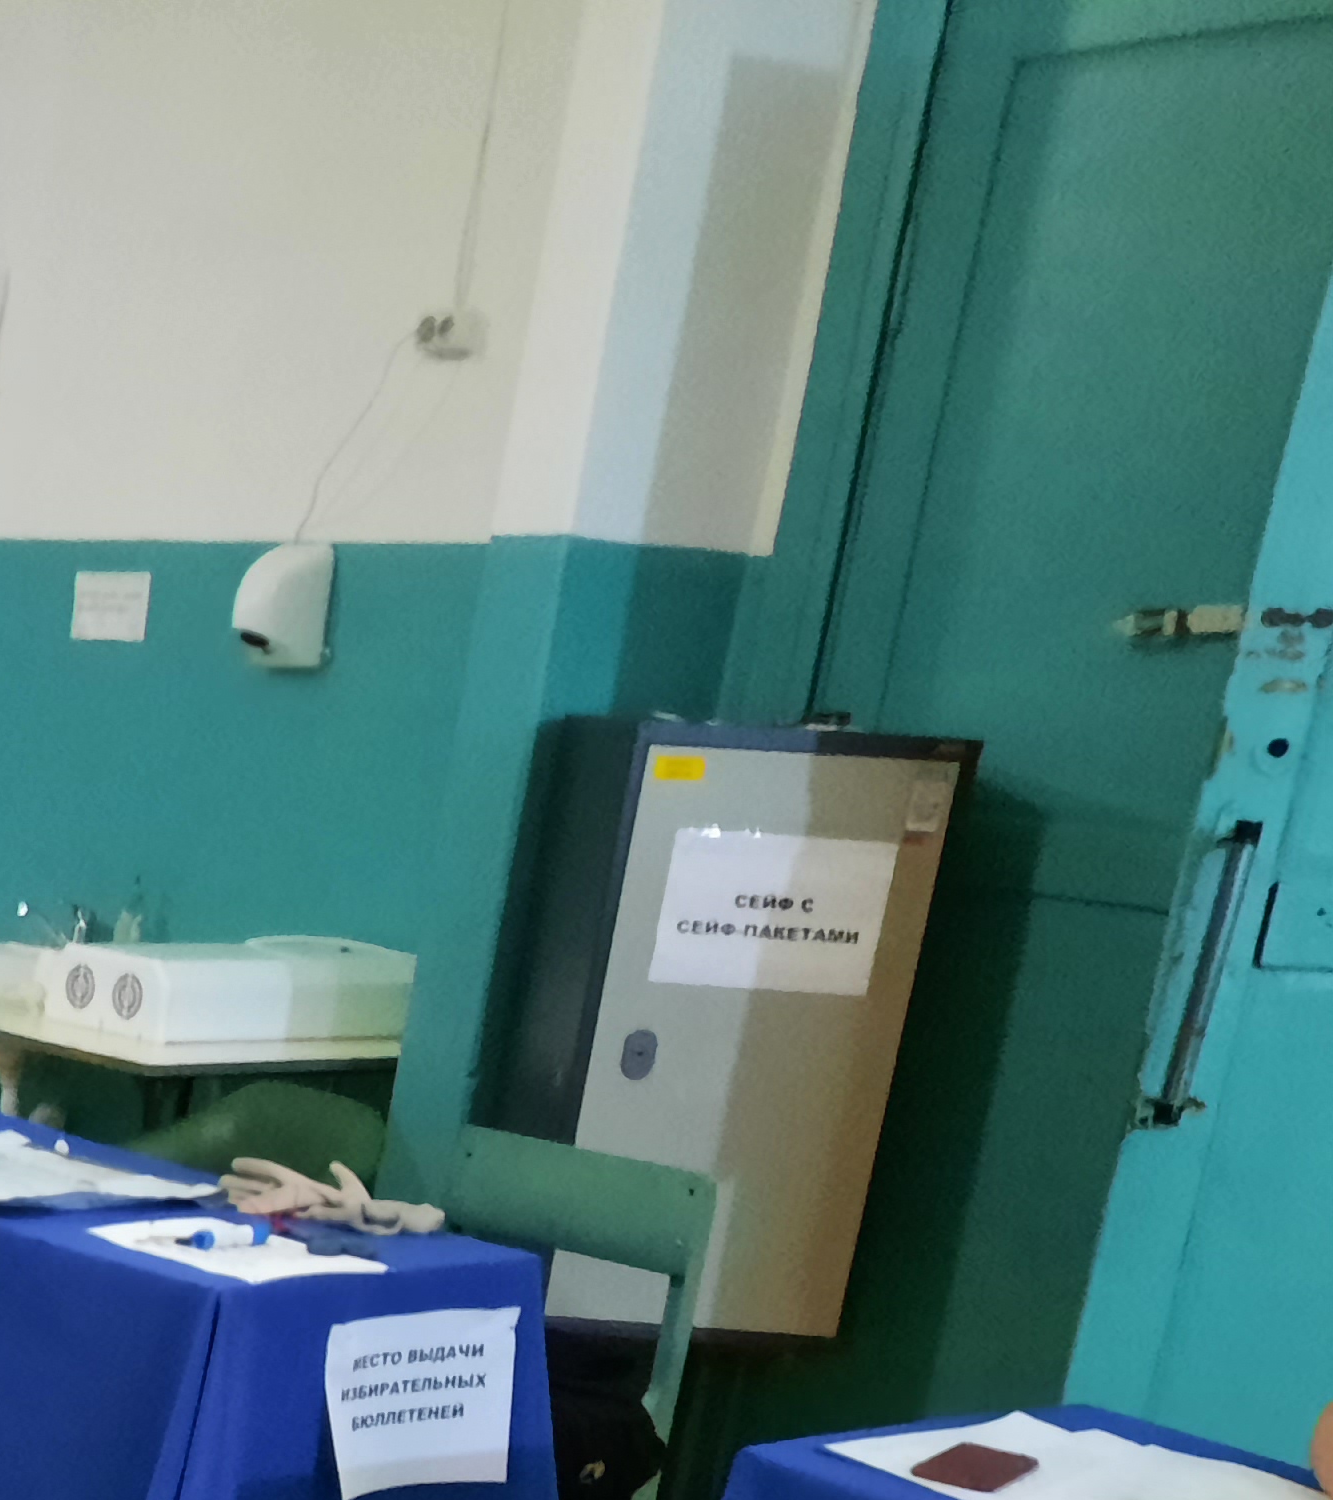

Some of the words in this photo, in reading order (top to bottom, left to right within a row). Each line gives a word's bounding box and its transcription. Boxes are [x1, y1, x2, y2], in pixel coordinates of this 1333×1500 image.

[735, 894, 794, 911] СЕЙФ
[801, 897, 814, 913] С
[352, 1351, 403, 1372] МЕСТО
[407, 1343, 485, 1364] ВЫДАЧИ
[341, 1373, 487, 1402] ИЗБИРАТЕЛЬНЫХ
[351, 1402, 465, 1432] БЮЛЛЕТЕНЕЙ
